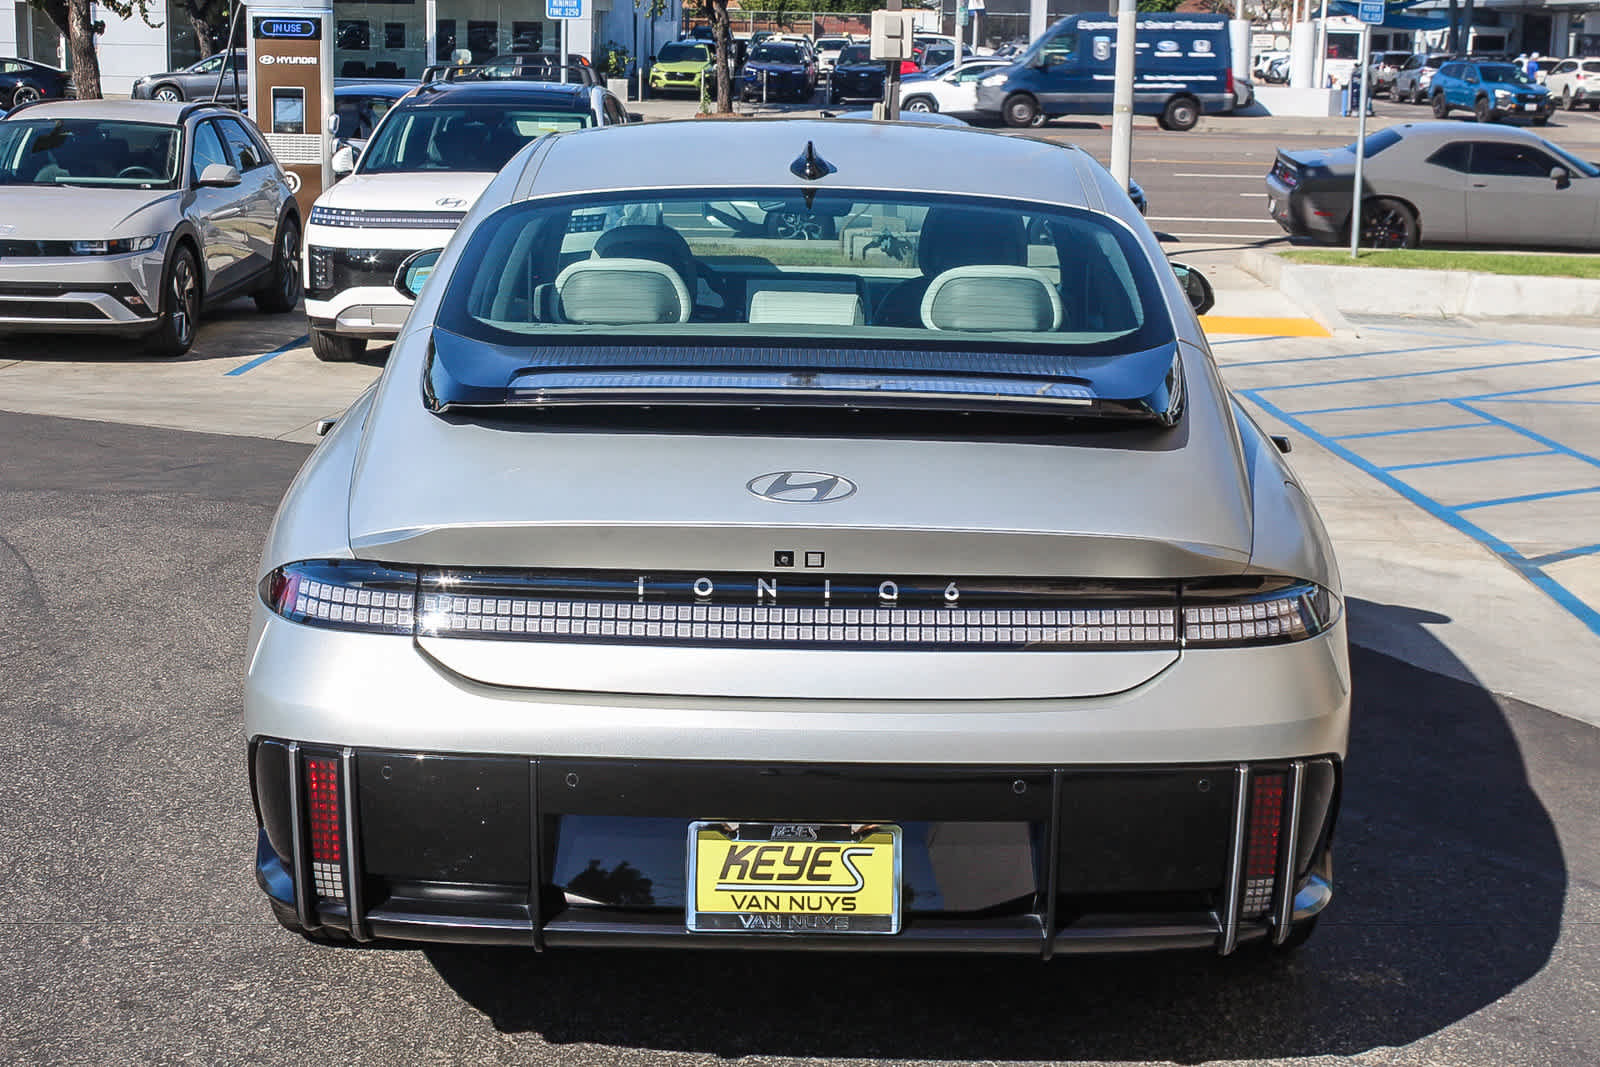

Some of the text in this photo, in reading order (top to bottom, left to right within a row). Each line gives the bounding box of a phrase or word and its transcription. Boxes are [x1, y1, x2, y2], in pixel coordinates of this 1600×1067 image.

[272, 24, 302, 33] IN USE
[276, 56, 318, 65] HYUNDAI
[944, 581, 960, 601] 6
[770, 825, 819, 842] KEYES
[716, 845, 876, 892] KEYES
[731, 894, 857, 912] VAN NUYS
[738, 914, 849, 930] VAN NUYS
